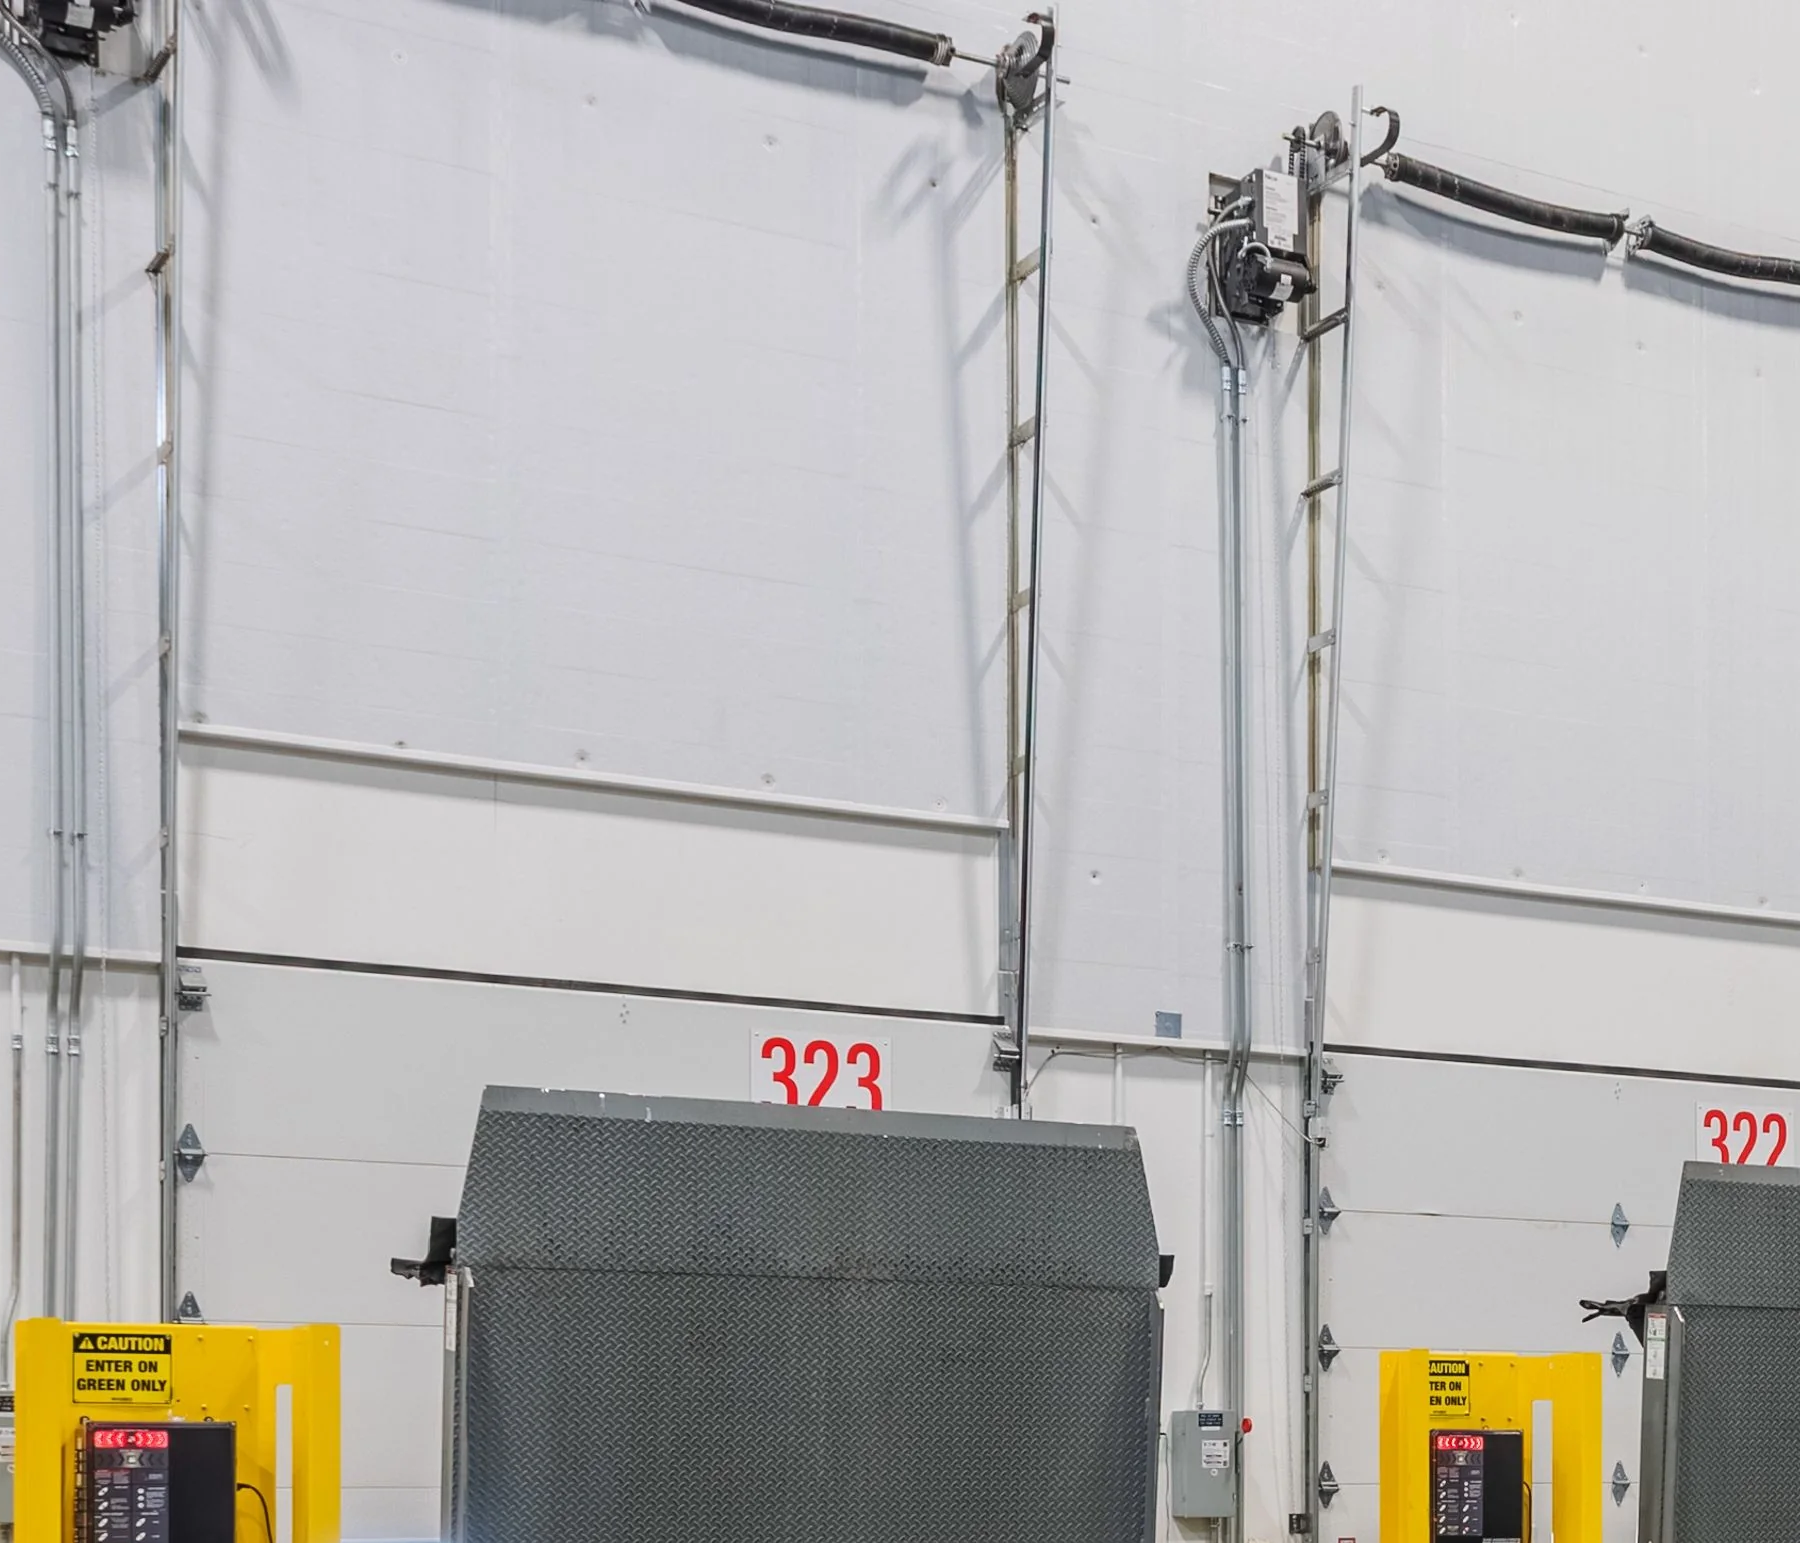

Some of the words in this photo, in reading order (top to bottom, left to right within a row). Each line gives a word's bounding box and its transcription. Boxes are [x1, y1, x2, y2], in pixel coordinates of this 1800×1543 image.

[761, 1037, 882, 1111] 323
[1704, 1109, 1787, 1166] 322
[97, 1336, 164, 1351] CAUTION
[86, 1360, 133, 1372] ENTER
[138, 1361, 158, 1373] ON
[1429, 1362, 1465, 1374] AUTION
[77, 1379, 125, 1390] GREEN
[131, 1380, 167, 1391] ONLY
[1430, 1381, 1446, 1391] TER
[1449, 1381, 1462, 1391] ON
[1445, 1396, 1467, 1406] ONLY
